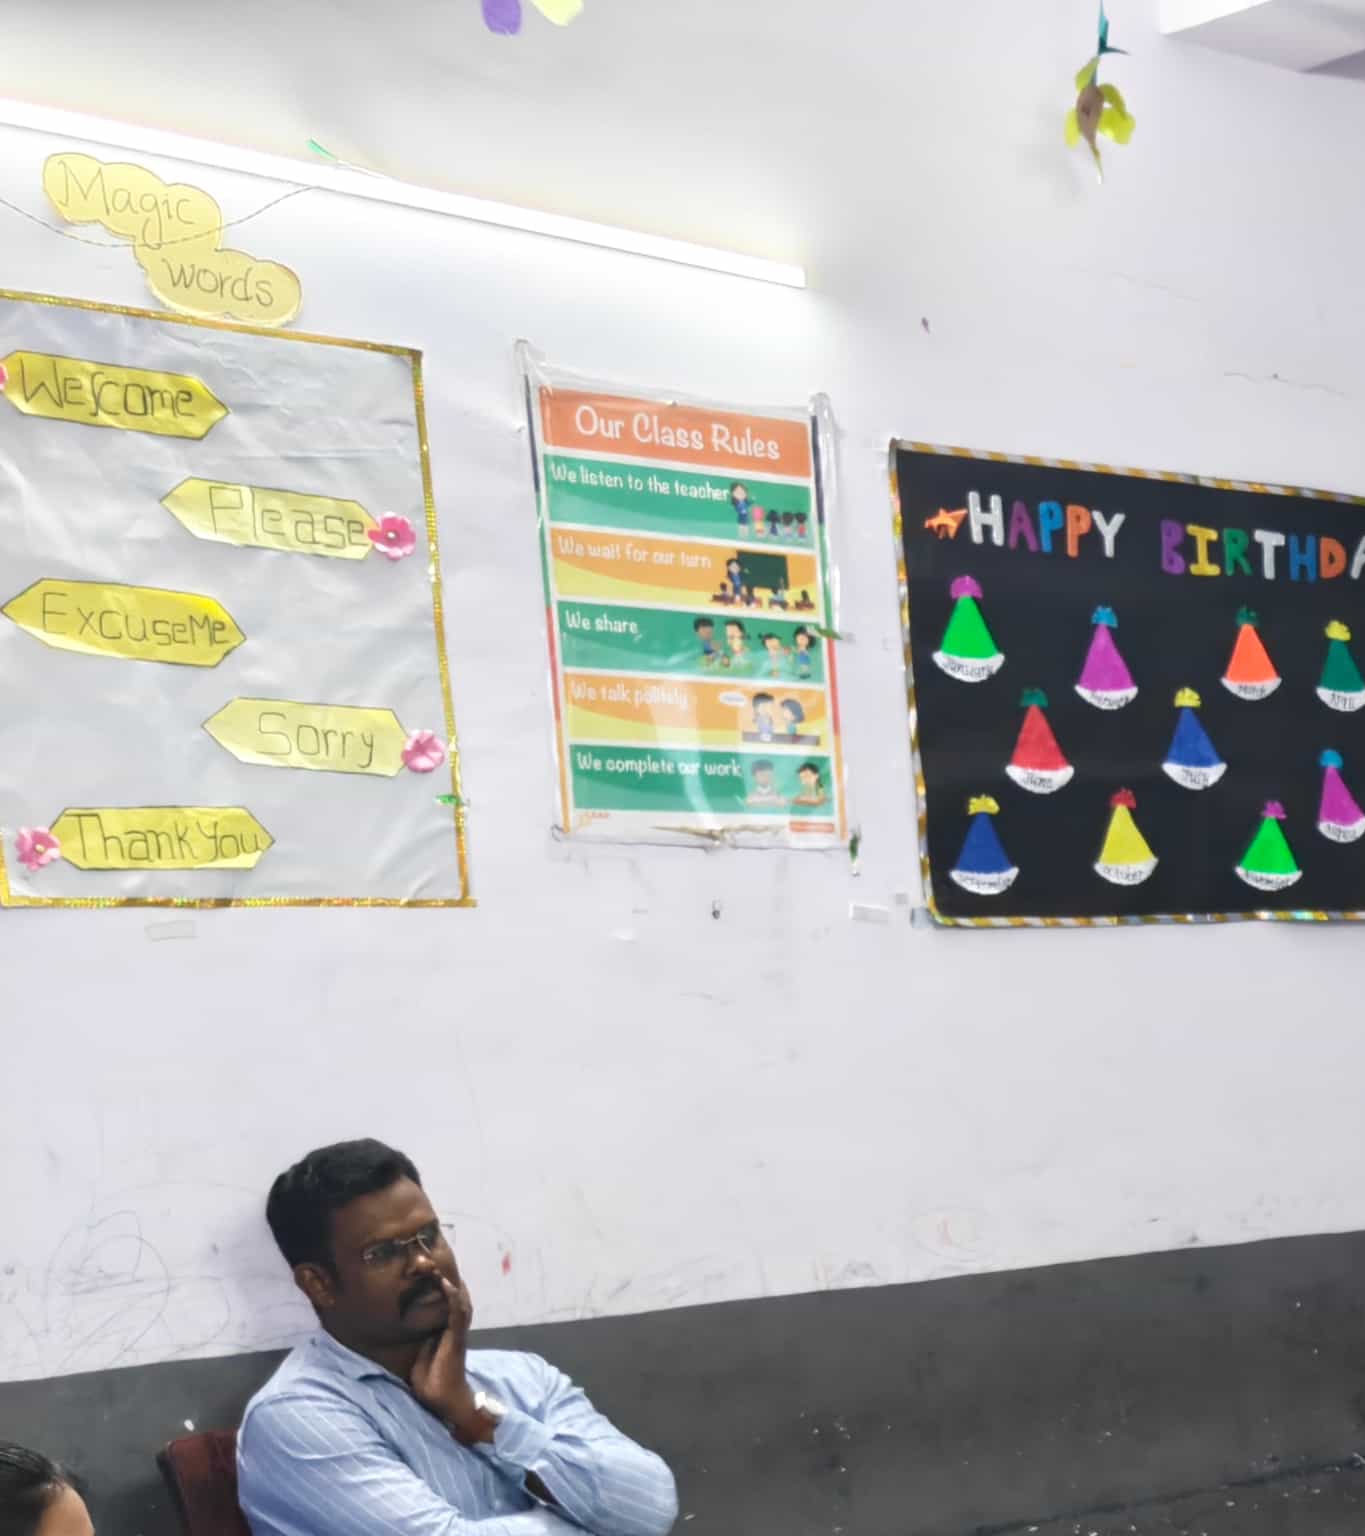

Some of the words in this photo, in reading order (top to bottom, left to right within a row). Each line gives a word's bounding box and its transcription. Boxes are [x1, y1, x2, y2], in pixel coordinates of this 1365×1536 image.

[57, 160, 195, 250] Magic
[161, 258, 274, 307] words
[575, 405, 624, 439] Our
[633, 413, 705, 450] Class
[712, 423, 781, 461] Rules
[551, 463, 576, 483] We
[580, 466, 623, 488] listen
[627, 473, 644, 491] to
[648, 474, 670, 495] the
[675, 477, 729, 501] teacher
[209, 486, 368, 549] Please
[968, 489, 1126, 560] HAPPY
[559, 536, 584, 556] We
[588, 543, 621, 559] wait
[626, 544, 649, 562] for
[653, 553, 675, 565] our
[681, 552, 712, 568] turn
[565, 610, 591, 630] We
[595, 614, 638, 634] share
[571, 681, 597, 700] We
[602, 684, 630, 703] talk
[256, 711, 375, 769] Sorry
[576, 752, 601, 770] We
[605, 756, 674, 778] complete
[678, 761, 700, 775] our
[705, 759, 741, 776] work
